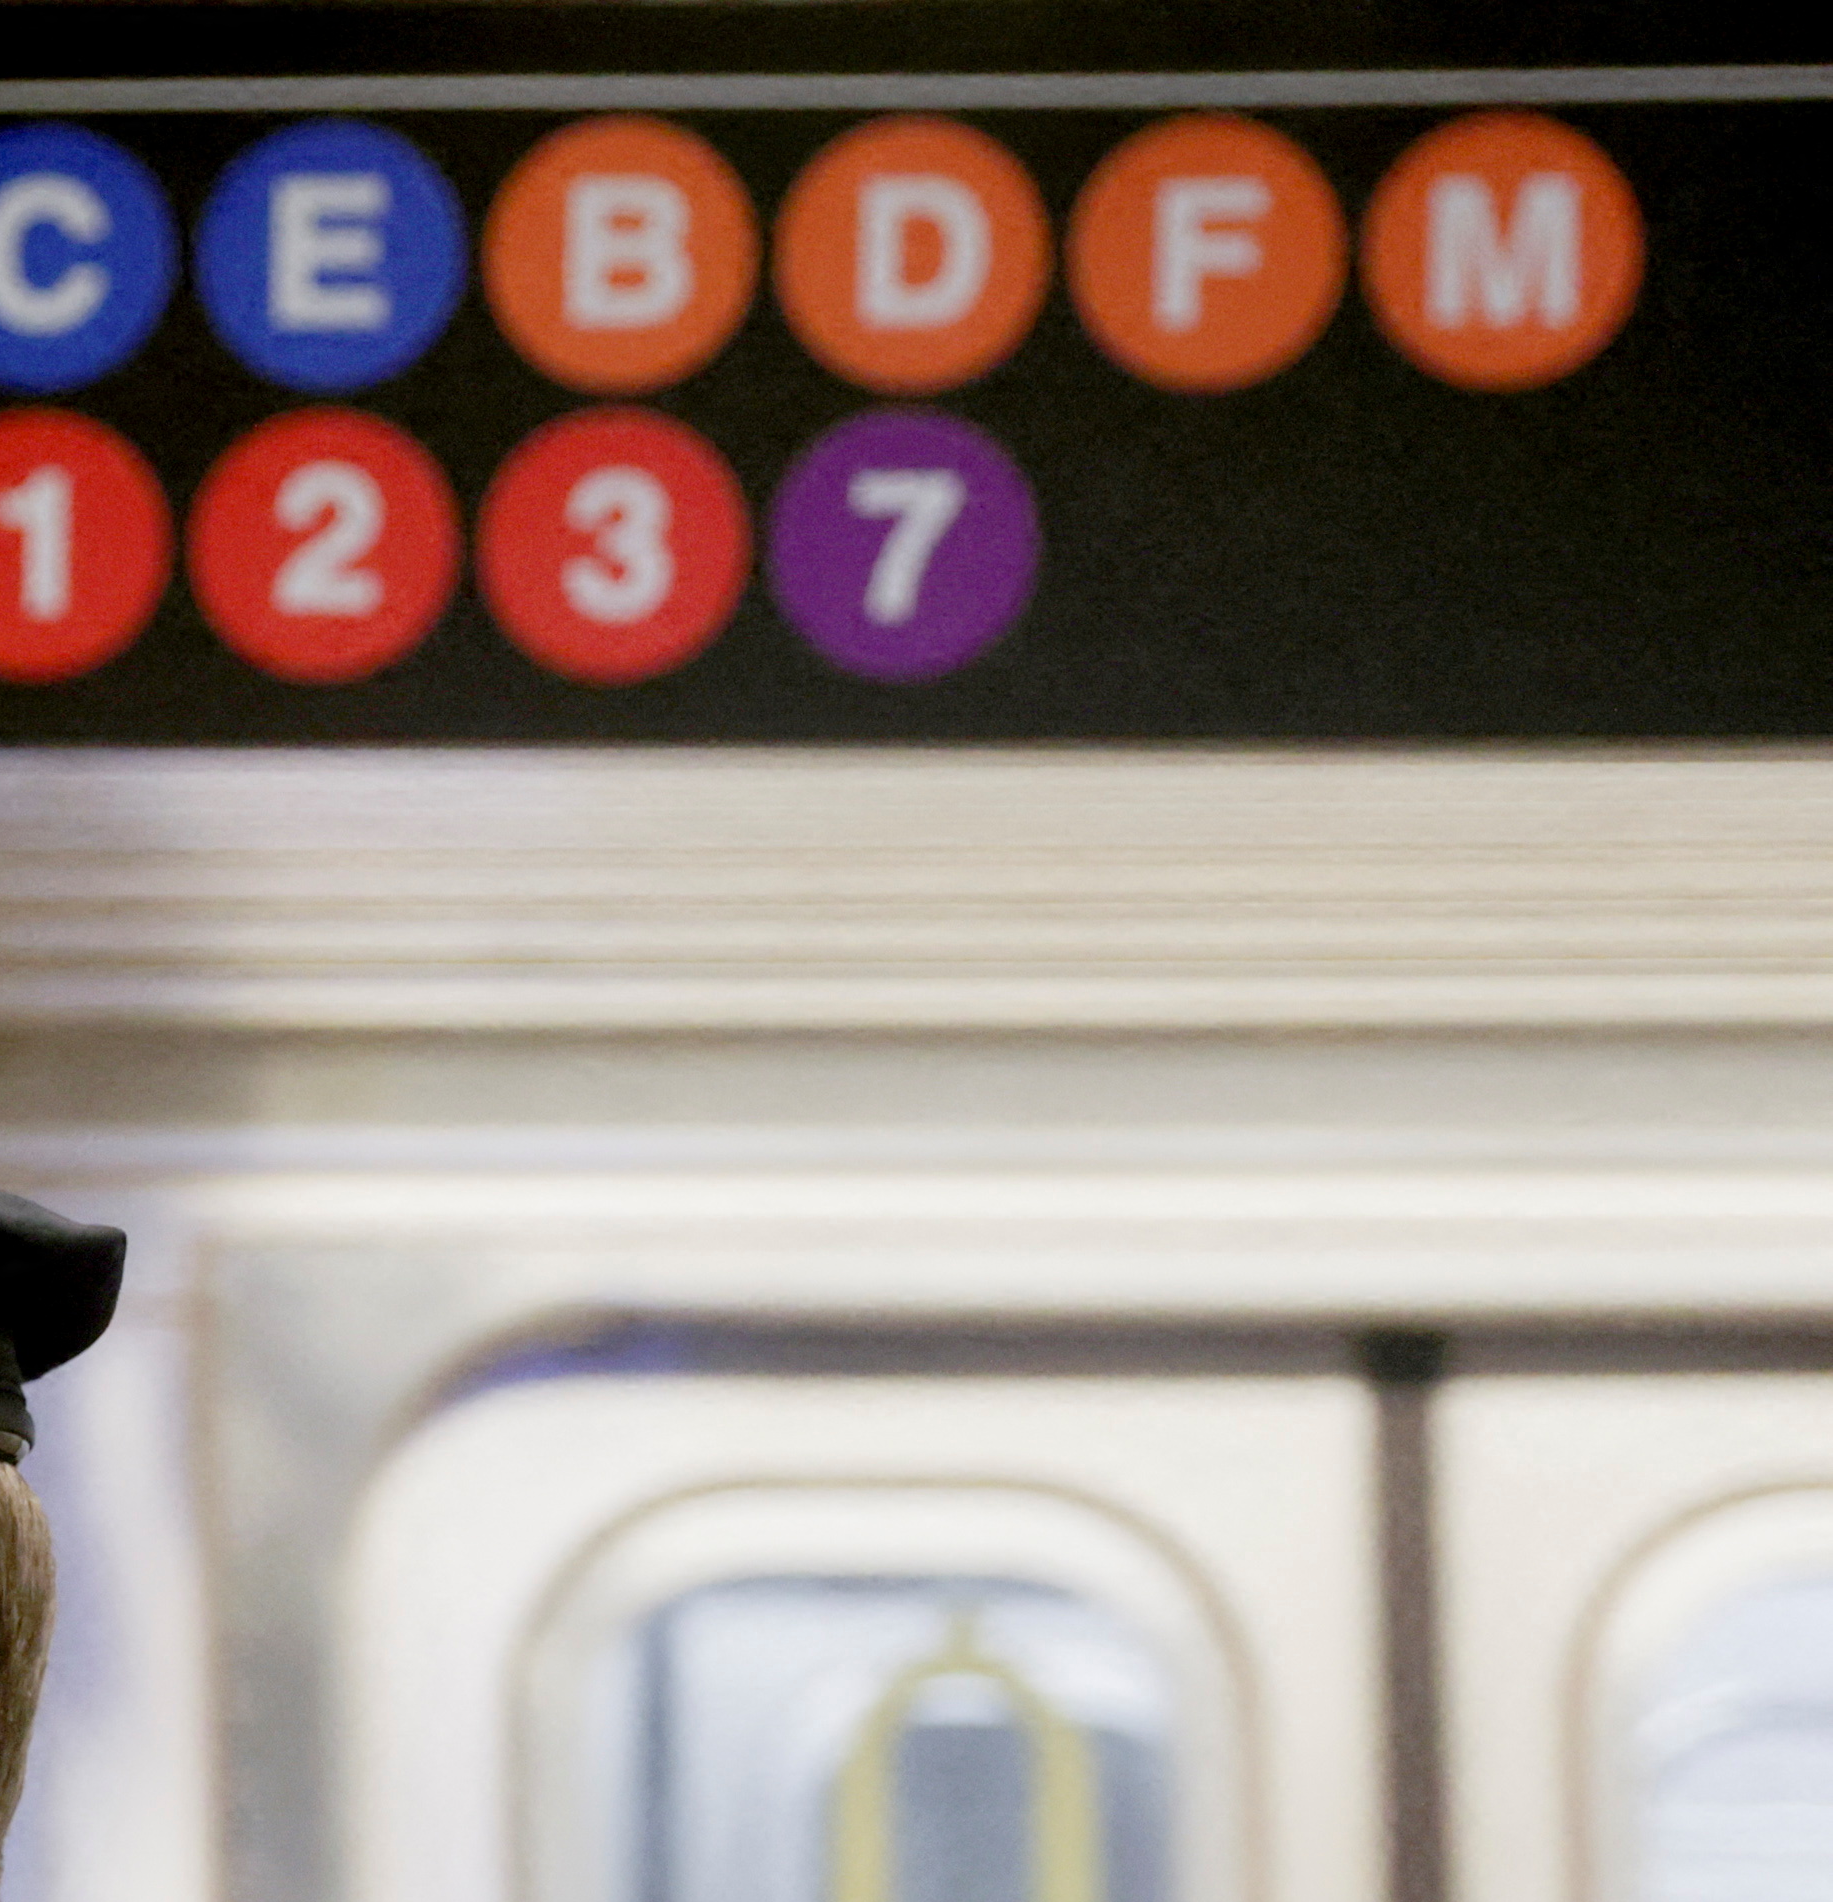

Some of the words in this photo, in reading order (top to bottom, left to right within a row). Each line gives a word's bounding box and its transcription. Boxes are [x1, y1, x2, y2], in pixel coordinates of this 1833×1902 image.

[267, 172, 392, 334] E
[563, 172, 695, 331] B
[854, 174, 992, 331] D
[1151, 175, 1273, 333] F
[1424, 172, 1583, 330] M
[270, 460, 385, 618] 2
[561, 464, 674, 625] 3
[846, 468, 967, 627] 7
